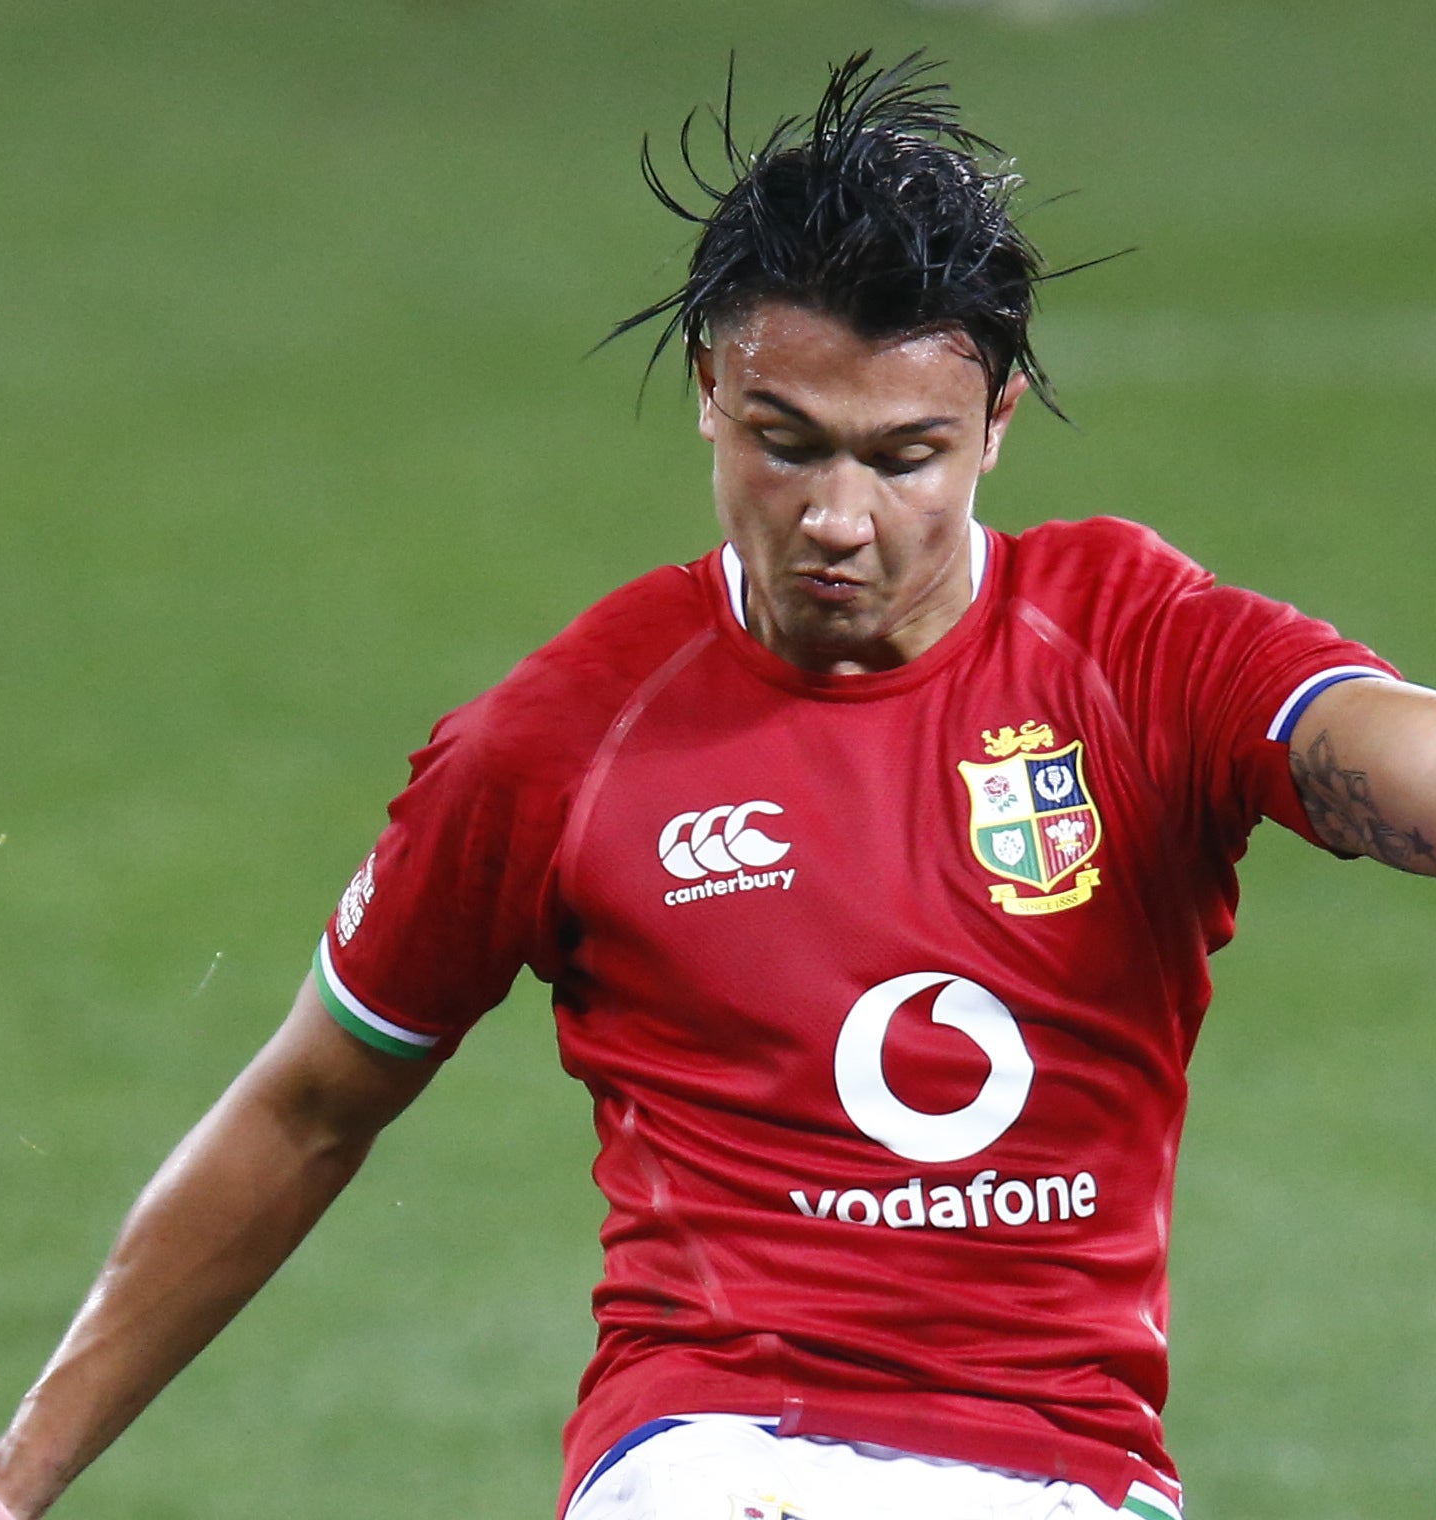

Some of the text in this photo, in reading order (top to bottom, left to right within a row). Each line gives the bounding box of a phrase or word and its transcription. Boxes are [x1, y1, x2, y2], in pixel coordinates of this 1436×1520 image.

[664, 868, 796, 906] canterbury
[1019, 893, 1078, 912] SINCE 1888
[789, 1169, 1098, 1229] vodafone
